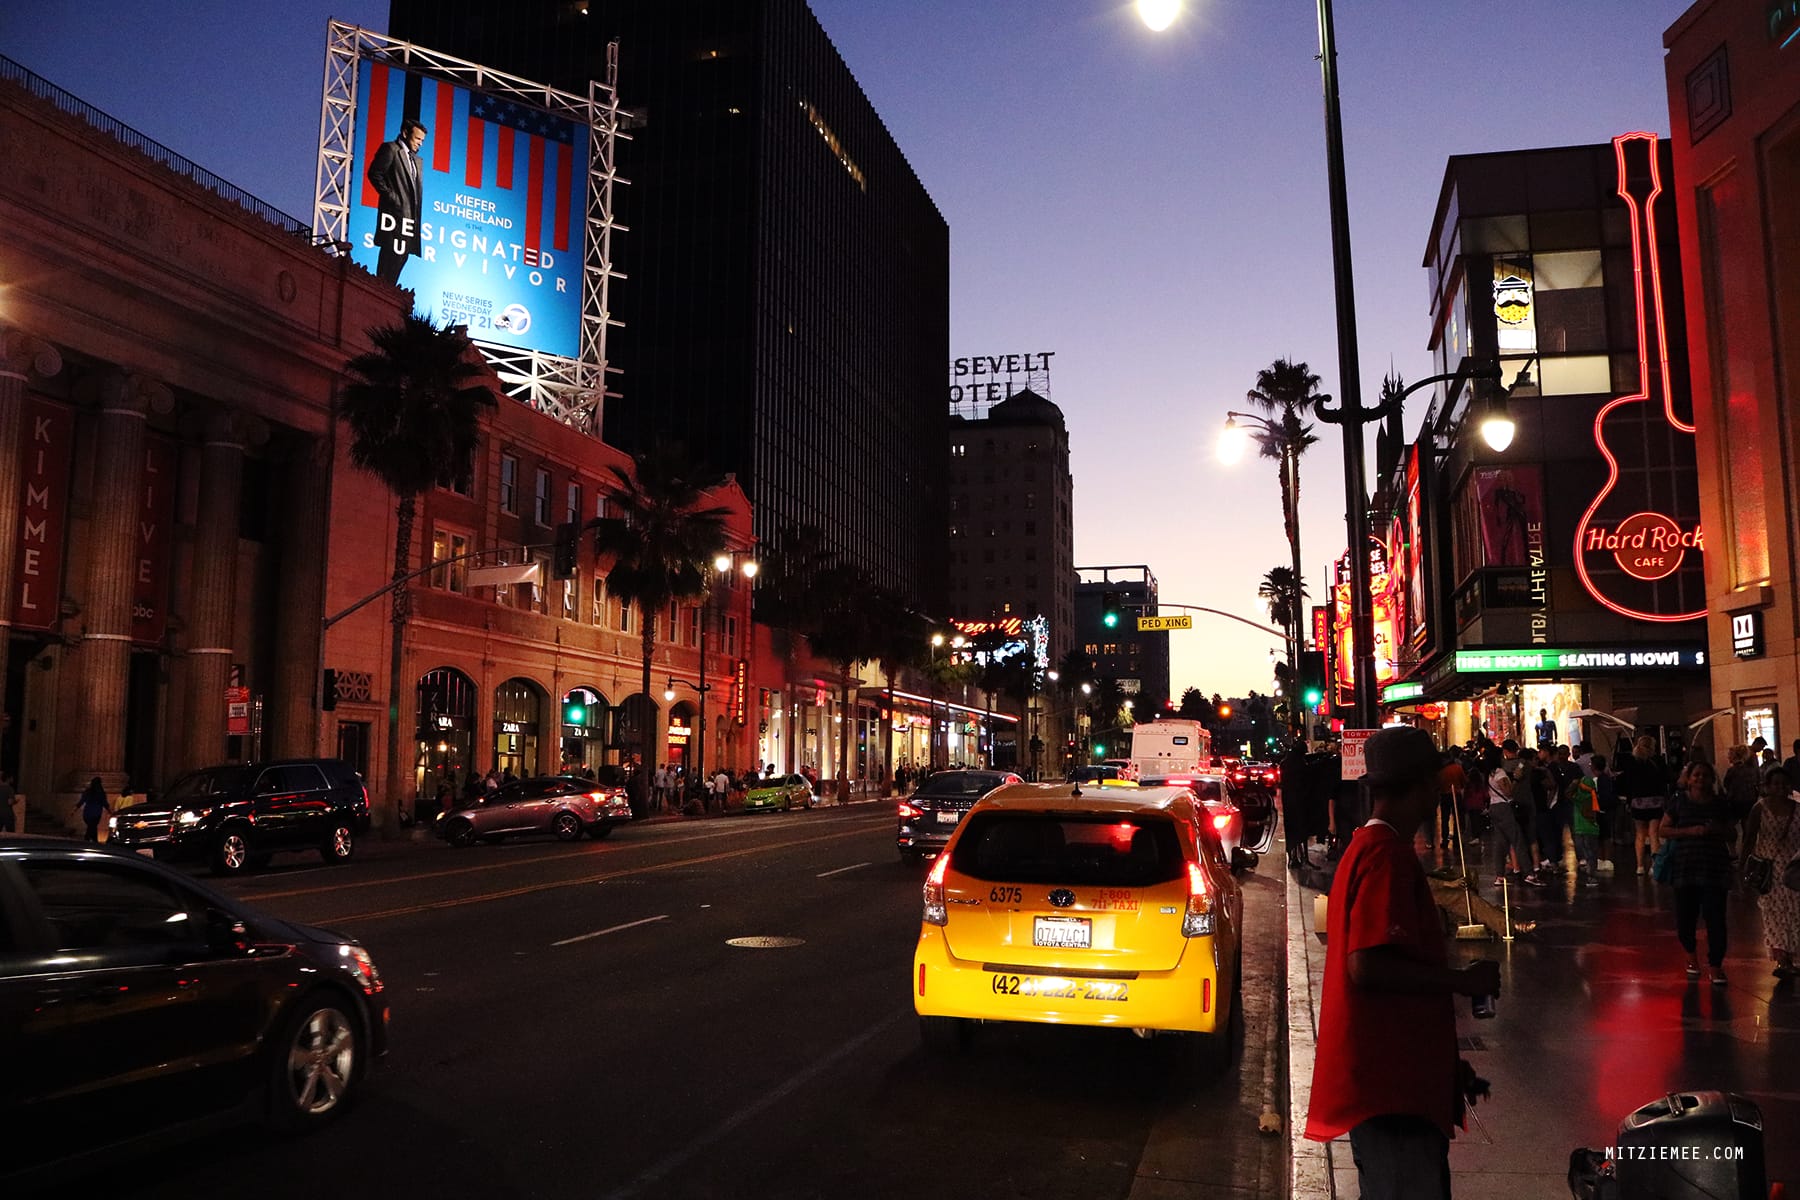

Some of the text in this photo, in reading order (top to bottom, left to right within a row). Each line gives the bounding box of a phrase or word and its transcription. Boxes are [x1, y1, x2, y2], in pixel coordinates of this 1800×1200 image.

[455, 193, 496, 213] KIEFER
[433, 200, 513, 230] SUTHERLAND
[380, 212, 555, 269] DESIGNATED
[363, 233, 567, 293] SURVIVOR
[442, 291, 493, 308] NEW SERIES
[442, 299, 493, 316] WEDNESDAY
[441, 308, 491, 329] SEPT 21
[21, 415, 50, 610] KIMMEL
[138, 448, 158, 583] LIVE
[1586, 525, 1704, 553] Hard Rock
[1634, 557, 1665, 567] CAFE
[1141, 618, 1188, 628] PED XING
[1558, 653, 1627, 667] SEATING
[1630, 651, 1679, 666] NOW!
[502, 722, 520, 733] ZARA
[1344, 743, 1355, 756] NO
[990, 886, 1022, 903] 6375
[1035, 940, 1060, 948] TOYOTA
